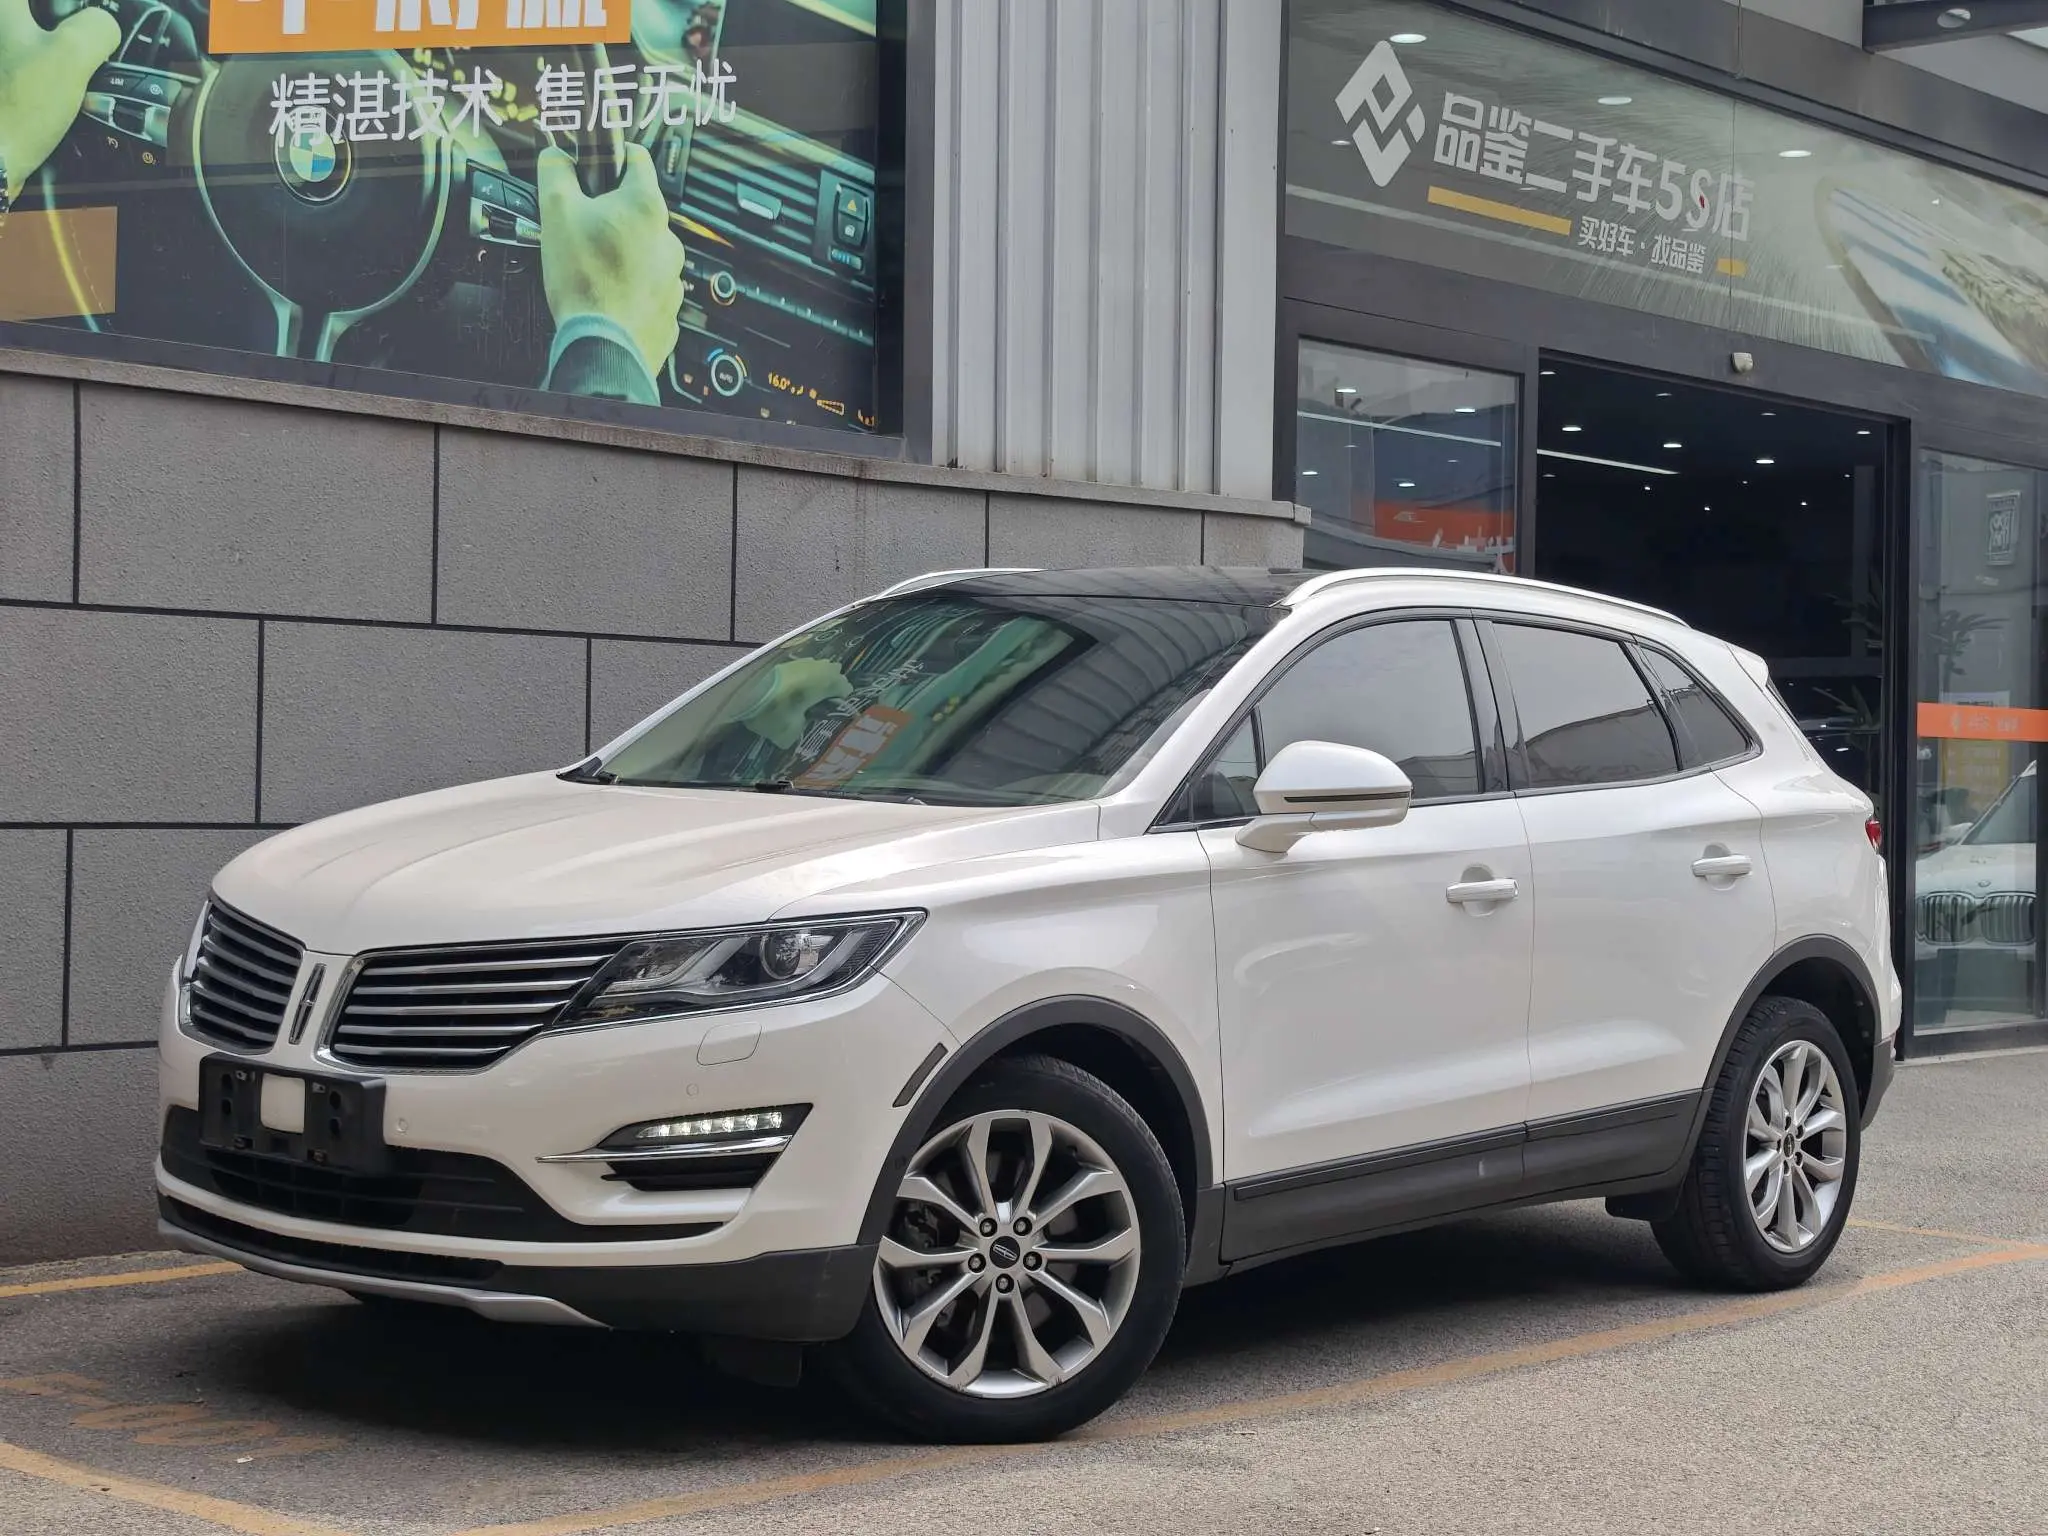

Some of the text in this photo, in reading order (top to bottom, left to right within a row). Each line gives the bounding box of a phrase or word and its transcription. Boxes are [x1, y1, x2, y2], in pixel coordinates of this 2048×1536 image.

[269, 58, 738, 149] 精湛技术 售后无忧
[1432, 90, 1755, 242] 品鉴二手车5S店
